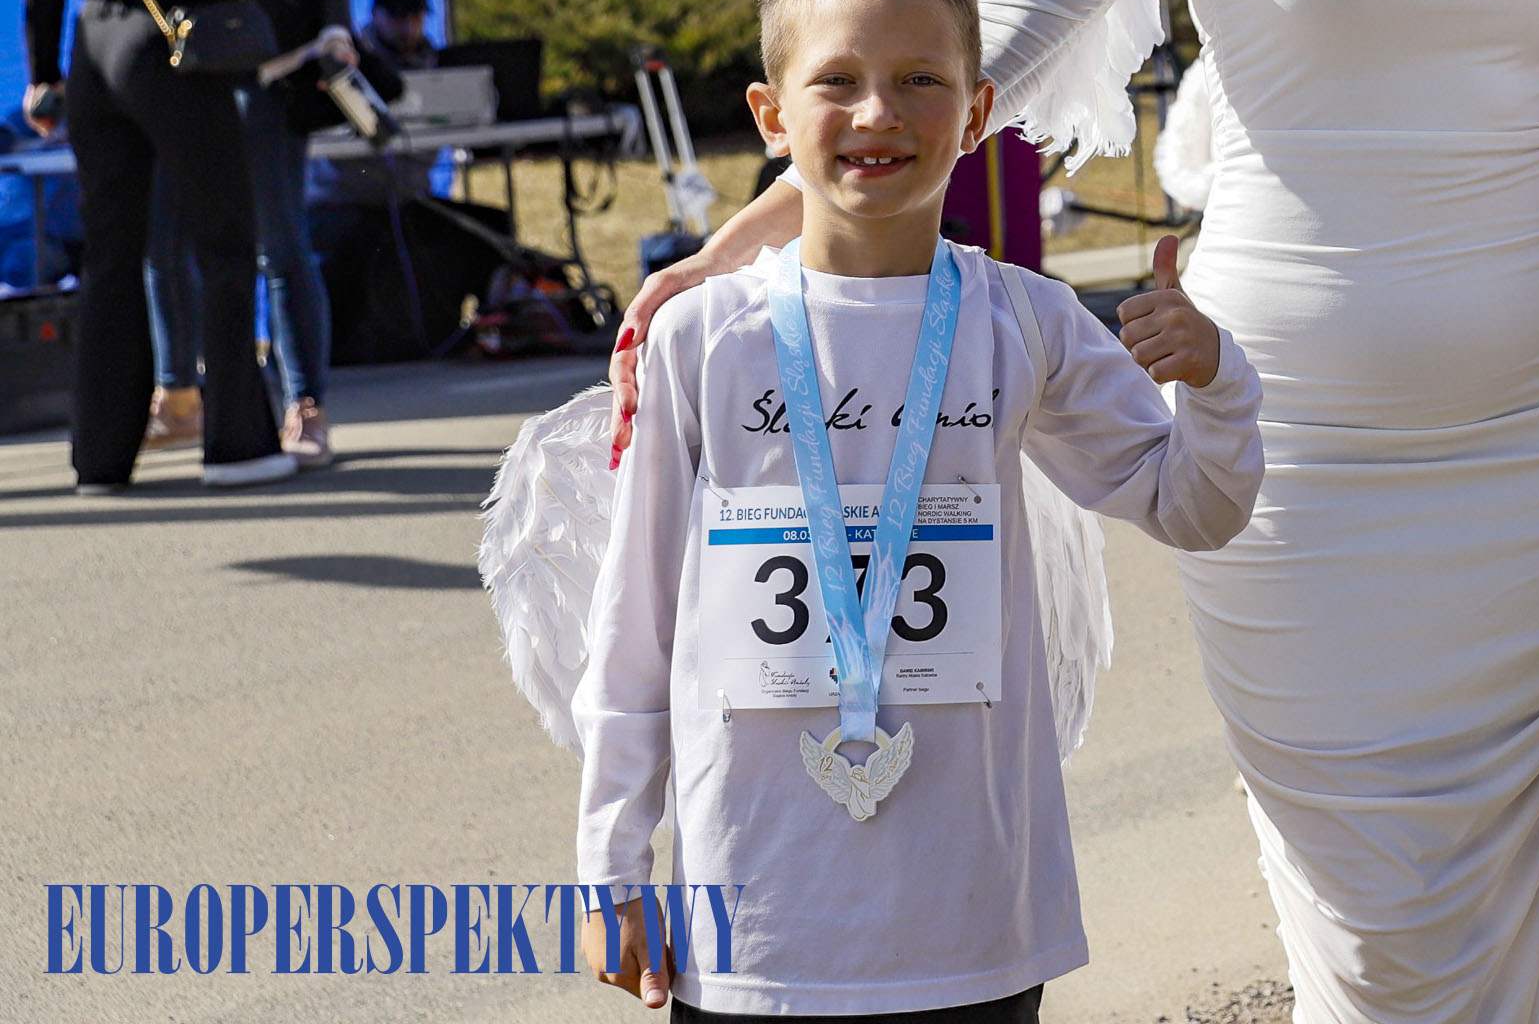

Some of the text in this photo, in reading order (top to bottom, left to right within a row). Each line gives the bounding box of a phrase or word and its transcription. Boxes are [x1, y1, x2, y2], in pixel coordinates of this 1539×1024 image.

[719, 508, 735, 522] 12.
[736, 508, 762, 521] BIEG
[764, 507, 808, 521] FUNDA
[818, 756, 834, 773] 12
